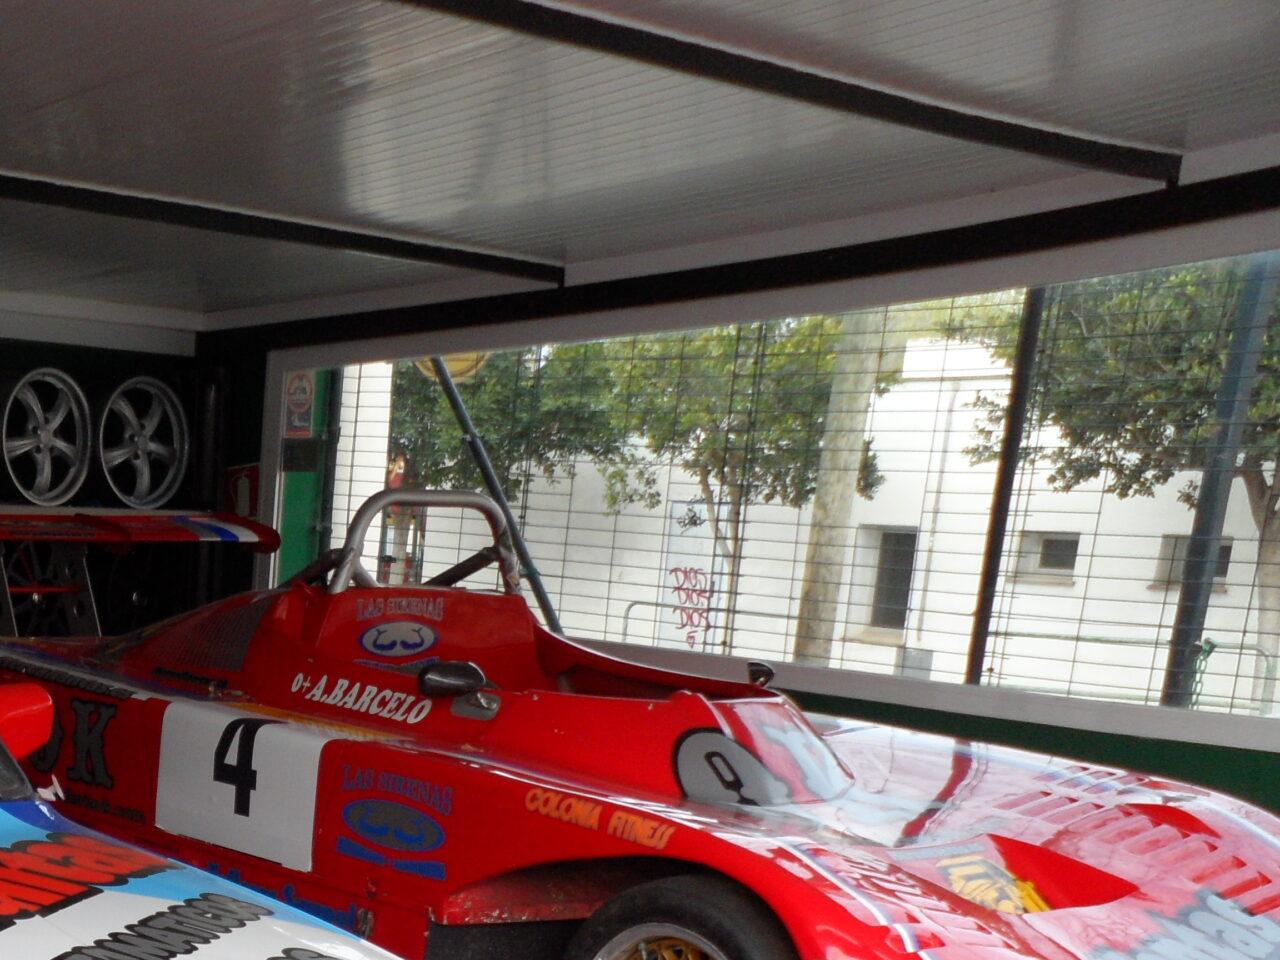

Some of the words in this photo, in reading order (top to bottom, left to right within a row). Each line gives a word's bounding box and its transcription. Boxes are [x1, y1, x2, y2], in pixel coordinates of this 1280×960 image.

[304, 674, 433, 724] A.BARCELO
[213, 717, 279, 818] 4
[524, 787, 604, 831] COLONIA
[606, 810, 677, 850] FITNESS
